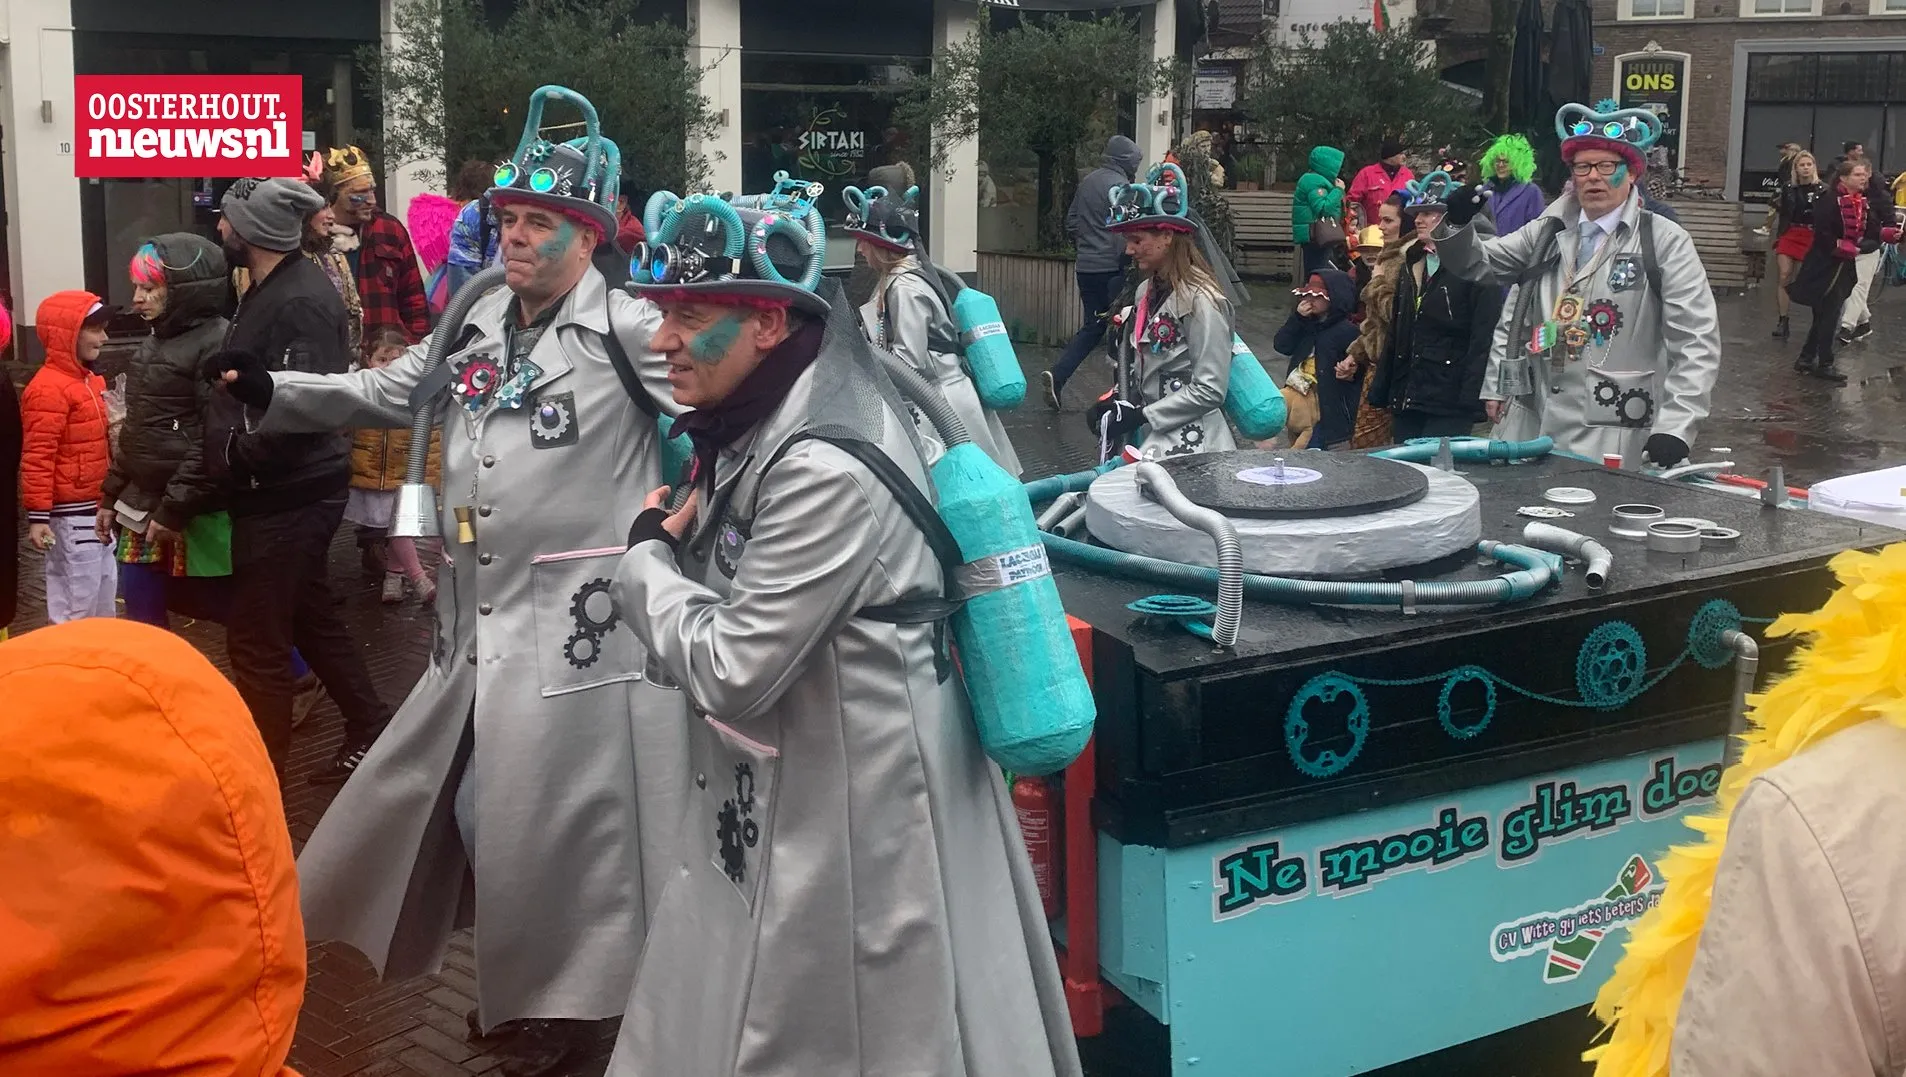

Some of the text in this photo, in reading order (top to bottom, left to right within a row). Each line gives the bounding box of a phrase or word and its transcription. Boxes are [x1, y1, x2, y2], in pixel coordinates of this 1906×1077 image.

[1627, 63, 1675, 74] HUUR
[1626, 73, 1675, 90] ONS
[60, 142, 71, 153] 10
[798, 130, 864, 150] SIRTAKI
[1222, 845, 1303, 910] Ne
[1321, 811, 1486, 887] mooie
[1503, 784, 1630, 858] glim
[1499, 931, 1517, 949] CV
[1521, 920, 1556, 944] Witte
[1578, 908, 1602, 926] iets
[1604, 896, 1644, 921] beters
[1647, 893, 1663, 909] da
